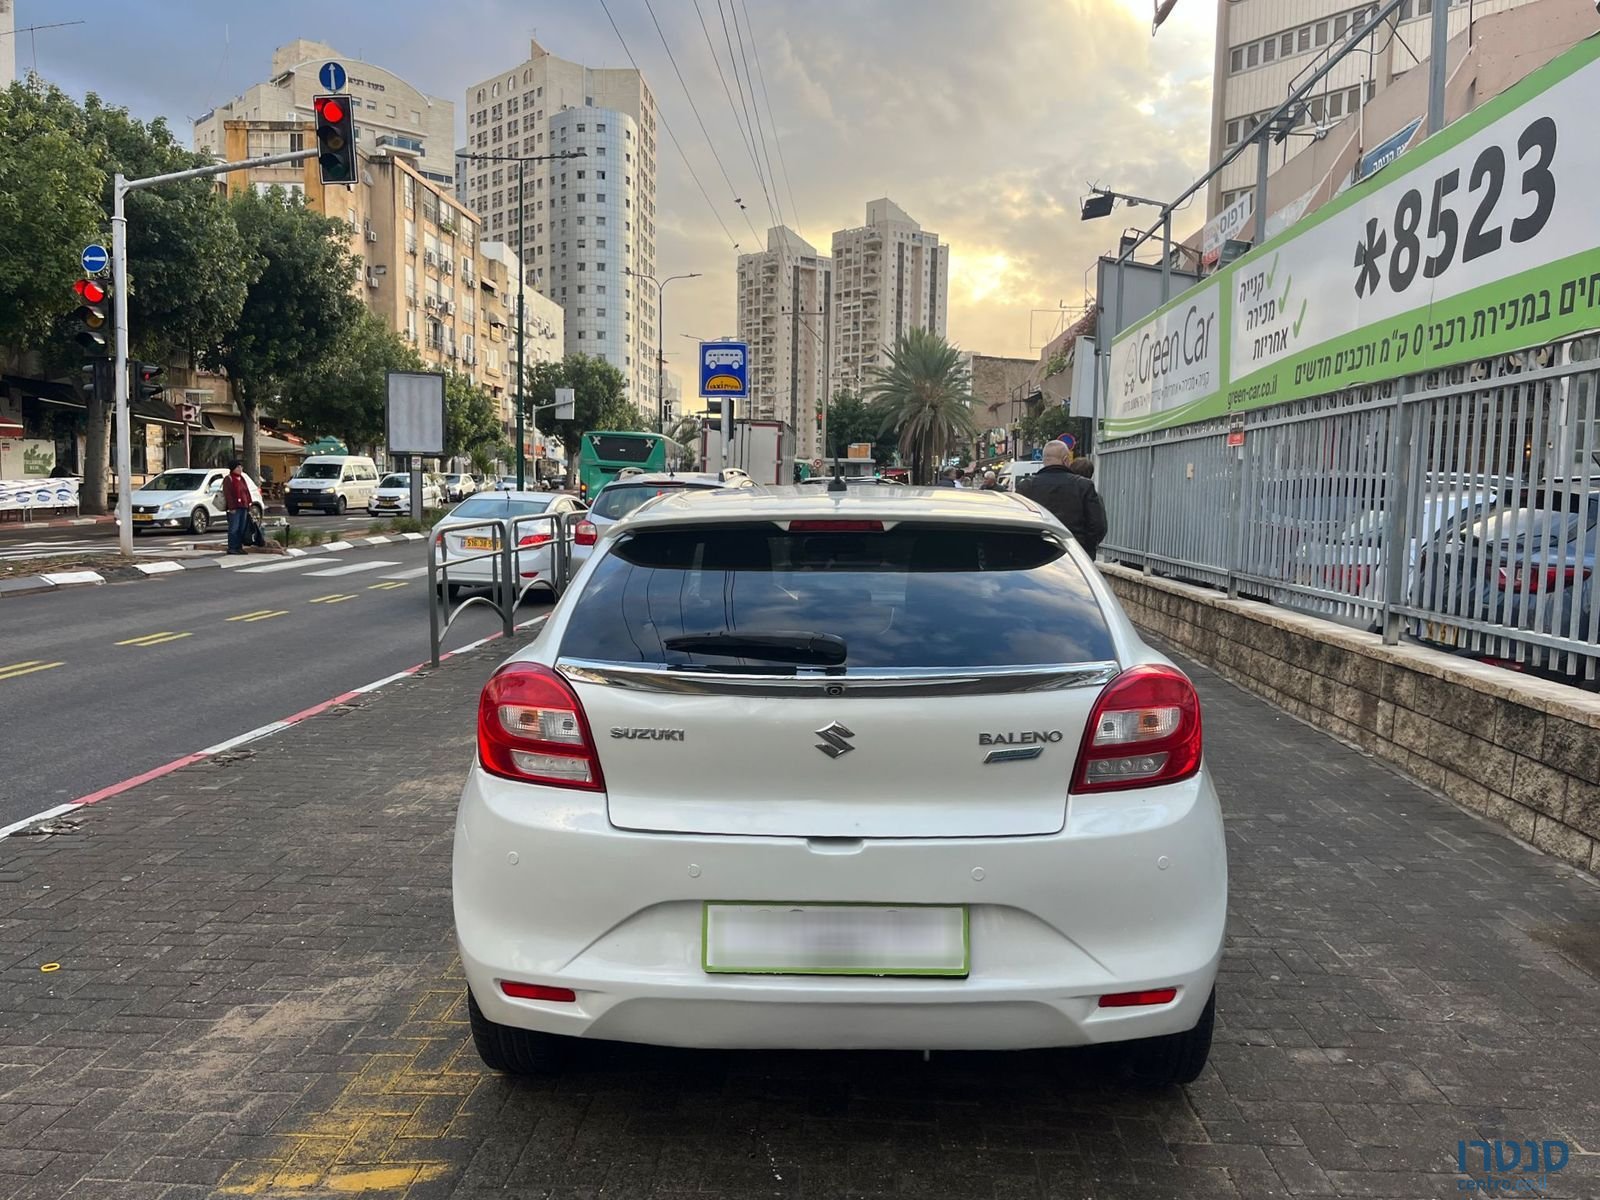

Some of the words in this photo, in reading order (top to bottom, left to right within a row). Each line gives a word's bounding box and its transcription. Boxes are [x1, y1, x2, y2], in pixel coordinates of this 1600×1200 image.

[1220, 201, 1245, 234] דפוס
[1239, 272, 1265, 303] קנייה
[1246, 299, 1275, 331] מכירה
[1470, 290, 1551, 340] במכירת
[1138, 332, 1180, 384] Green
[1183, 305, 1214, 366] Car
[1253, 327, 1289, 361] אחריות
[1413, 323, 1423, 356] 0
[1428, 316, 1466, 351] רכבי
[1294, 355, 1332, 385] חדשים
[1334, 341, 1376, 375] ורכבים
[1228, 374, 1278, 410] green-car.co.il
[610, 727, 685, 741] SUZUKI
[978, 730, 1063, 745] BALENO
